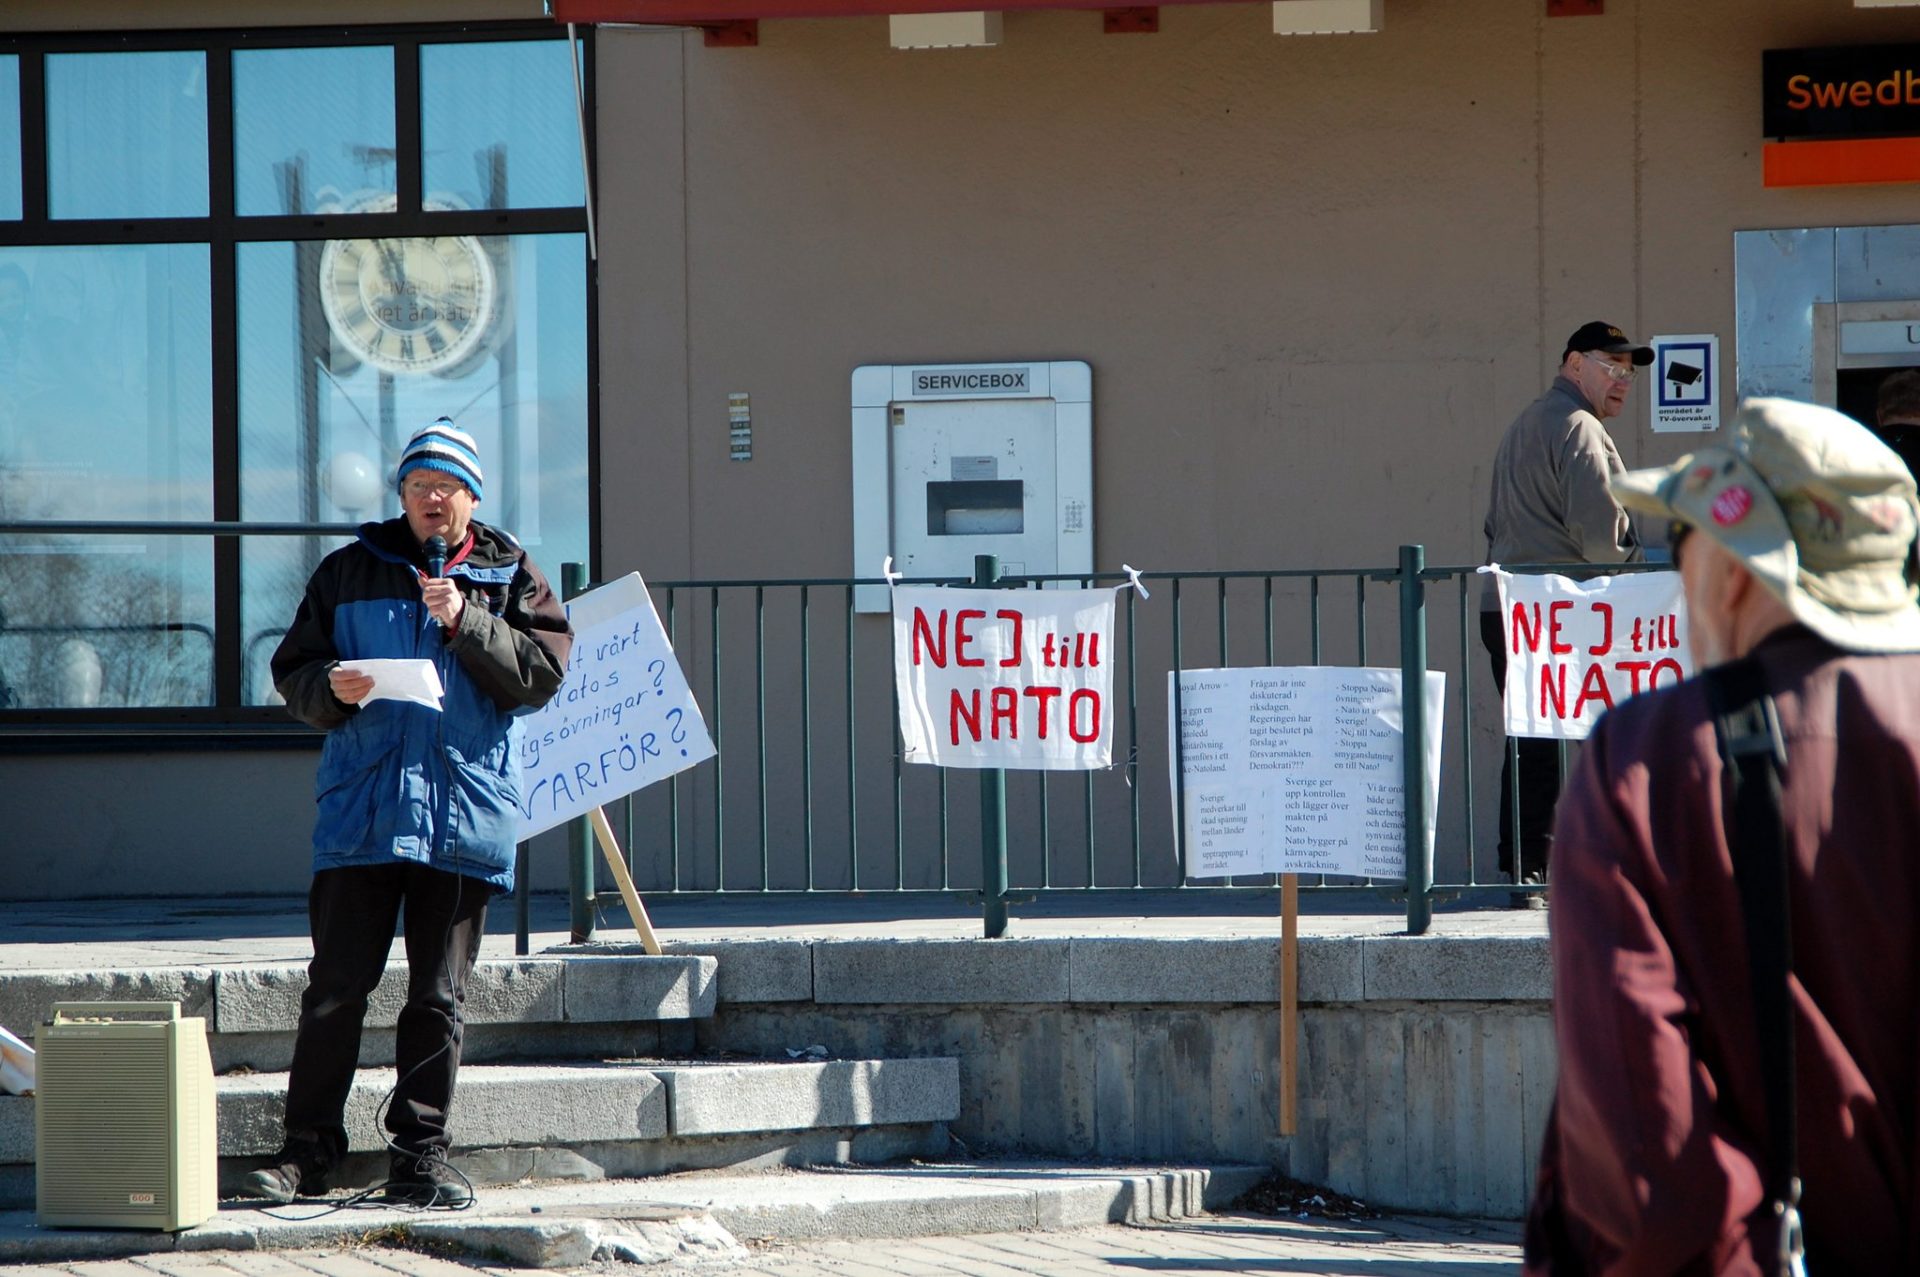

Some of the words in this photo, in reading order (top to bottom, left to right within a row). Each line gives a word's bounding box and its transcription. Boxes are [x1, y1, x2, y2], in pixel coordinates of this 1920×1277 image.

[918, 373, 1025, 390] SERVICEBOX
[1659, 407, 1693, 415] området
[1512, 600, 1613, 656] NEJ
[1630, 614, 1680, 653] till
[596, 622, 640, 661] vårt
[912, 606, 1023, 668] NEJ
[1042, 632, 1100, 667] till
[1179, 682, 1197, 694] oyal
[1199, 682, 1221, 690] Arrow
[1250, 680, 1278, 691] Frågan
[1280, 680, 1289, 688] är
[1291, 679, 1306, 688] inte
[1341, 683, 1368, 694] Stoppa
[1370, 684, 1393, 693] Nato-
[1540, 658, 1685, 719] NATO
[544, 669, 619, 713] Natos
[1250, 691, 1292, 700] diskuterad
[1341, 705, 1360, 713] Nato
[950, 685, 1101, 746] NATO
[1250, 715, 1296, 726] Regeringen
[1298, 715, 1312, 723] har
[1335, 716, 1368, 727] Sverige!
[1249, 726, 1268, 737] tagit
[1269, 726, 1301, 735] beslutet
[1303, 726, 1313, 736] på
[1341, 728, 1355, 738] Nej
[1357, 727, 1368, 737] till
[1369, 729, 1391, 738] Nato!
[1249, 738, 1278, 748] förslag
[1340, 739, 1367, 749] Stoppa
[1334, 751, 1395, 763] smyganslutning
[516, 707, 688, 821] VARFÖR?
[1334, 762, 1344, 770] en
[1345, 761, 1357, 770] till
[1358, 761, 1381, 771] Nato!
[1285, 777, 1316, 788] Sverige
[1319, 780, 1332, 788] ger
[1367, 783, 1377, 792] Vi
[1378, 784, 1387, 792] är
[1199, 794, 1225, 803] Sverige
[1285, 791, 1301, 799] upp
[1303, 789, 1346, 798] kontrollen
[1366, 795, 1384, 804] både
[1386, 797, 1395, 805] ur
[1236, 803, 1247, 812] till
[1285, 801, 1300, 809] och
[1303, 801, 1328, 811] lägger
[1330, 801, 1349, 810] över
[1285, 812, 1316, 821] makten
[1318, 813, 1328, 823] på
[1285, 825, 1308, 833] Nato.
[1365, 820, 1379, 828] och
[1201, 827, 1223, 836] mellan
[1365, 831, 1402, 841] synvinkel
[1202, 839, 1213, 847] och
[1285, 837, 1305, 845] Nato
[1307, 837, 1336, 848] bygger
[1338, 838, 1348, 847] på
[1364, 842, 1379, 851] den
[1285, 848, 1331, 858] kärnvapen-
[1364, 854, 1402, 865] Natoledda
